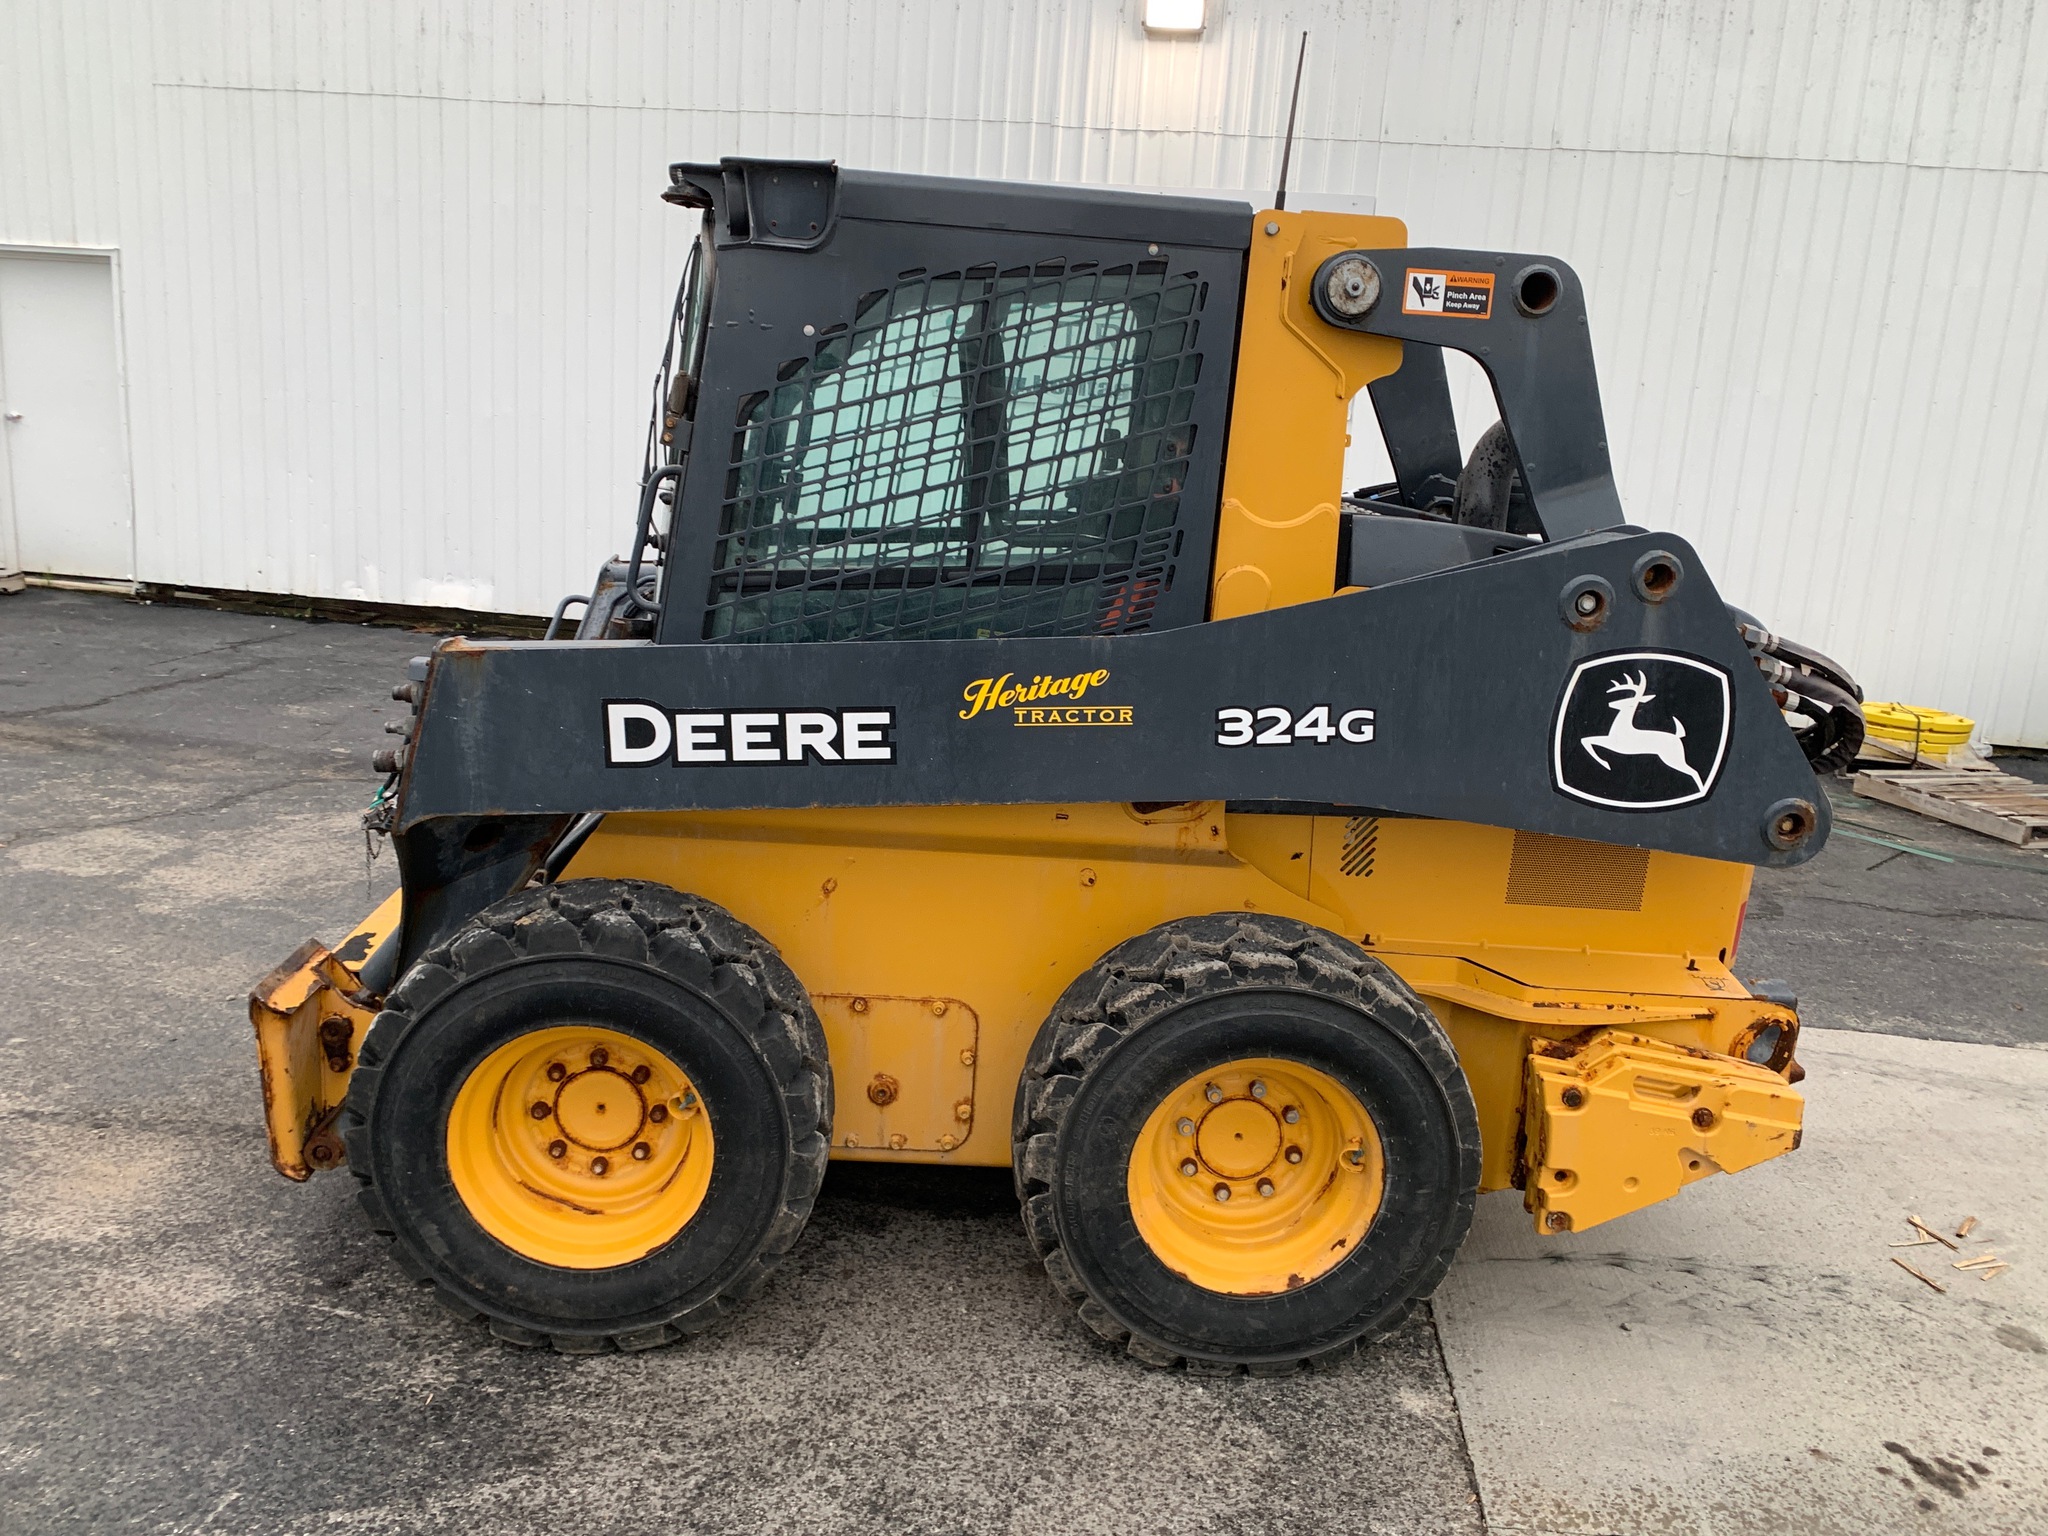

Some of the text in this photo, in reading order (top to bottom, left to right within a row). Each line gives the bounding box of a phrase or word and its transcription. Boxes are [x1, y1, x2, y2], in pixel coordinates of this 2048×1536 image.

[1456, 276, 1490, 285] WARNING
[1446, 291, 1487, 301] Pinch Area
[1445, 300, 1481, 311] Keep Away
[959, 668, 1111, 720] Heritage
[1014, 709, 1133, 723] TRACTOR
[608, 703, 891, 763] DEERE
[1217, 707, 1374, 746] 324G
